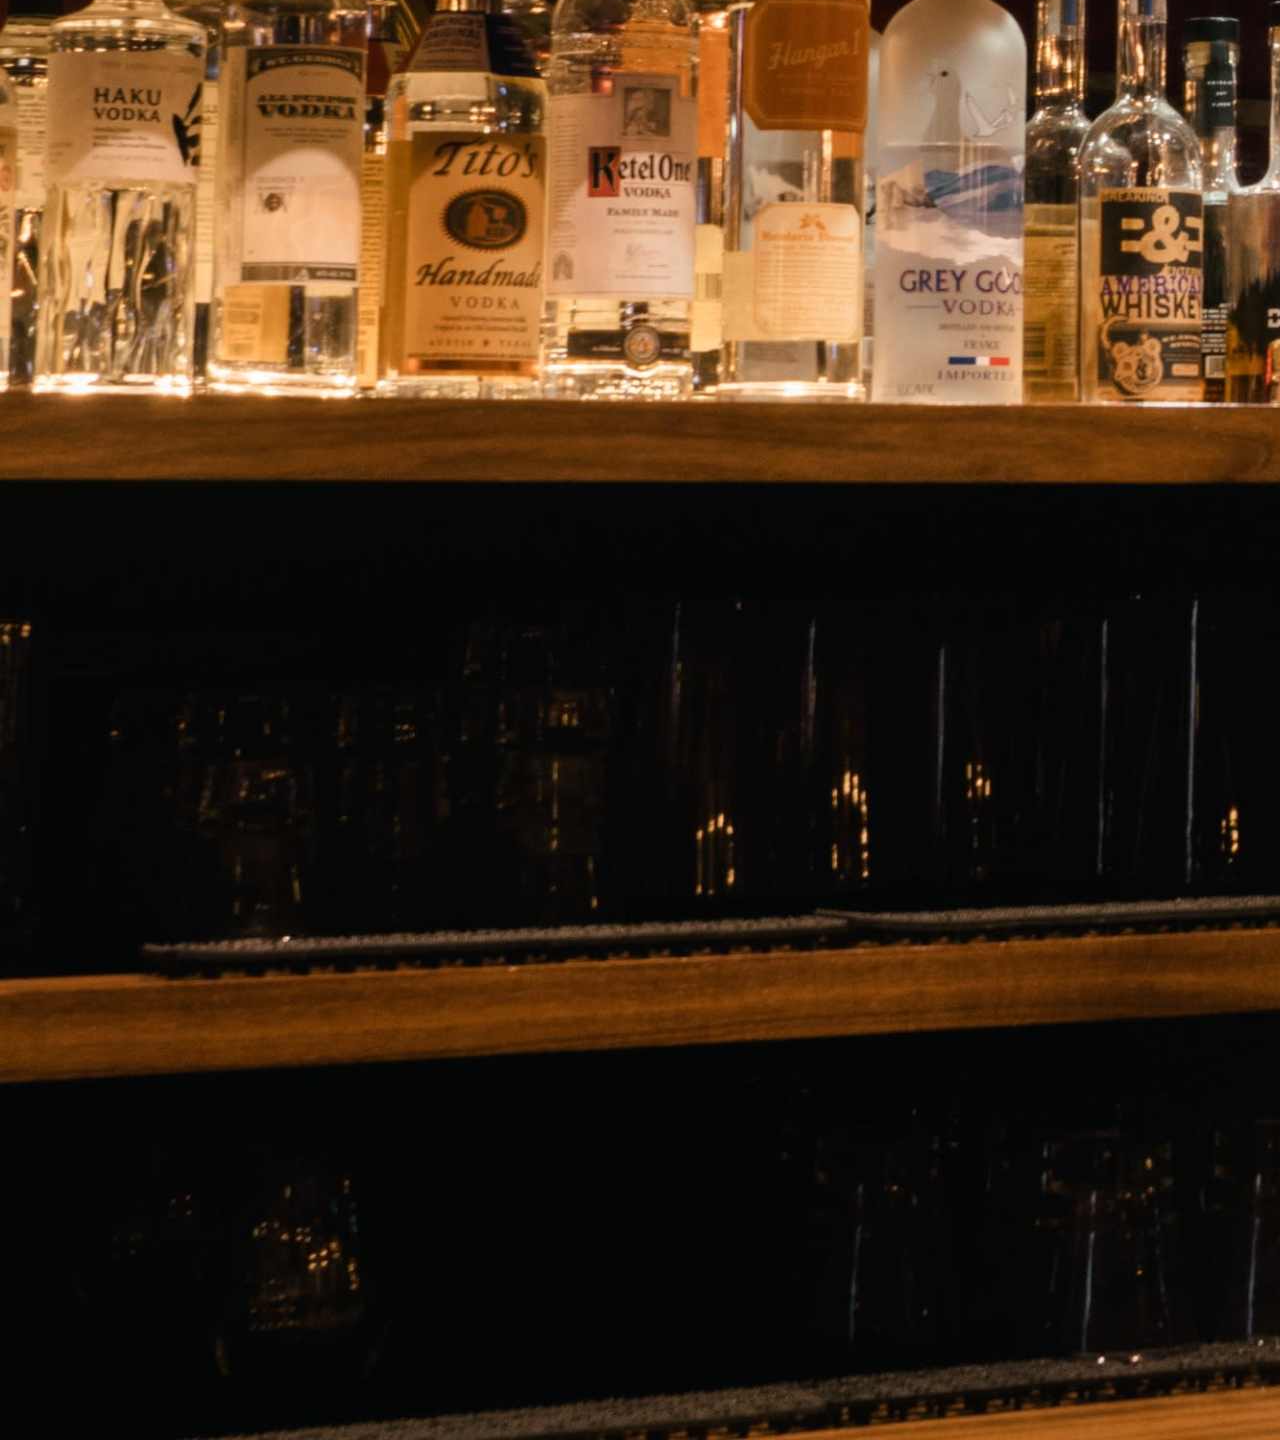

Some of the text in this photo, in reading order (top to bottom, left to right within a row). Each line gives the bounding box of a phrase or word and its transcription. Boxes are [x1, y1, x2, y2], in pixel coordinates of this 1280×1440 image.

[768, 40, 848, 71] Hangar
[93, 87, 162, 106] HAKU
[93, 107, 162, 123] VODKA
[258, 105, 355, 122] VODKA
[433, 137, 539, 179] Tito's
[592, 147, 691, 192] Ketel One
[623, 185, 672, 200] VODKA
[606, 207, 649, 218] FAMILY
[900, 269, 968, 294] GREY
[1101, 275, 1201, 296] AMERICA
[450, 295, 521, 311] VODKA
[942, 299, 1016, 317] VODKA
[1101, 293, 1201, 320] WHISKE
